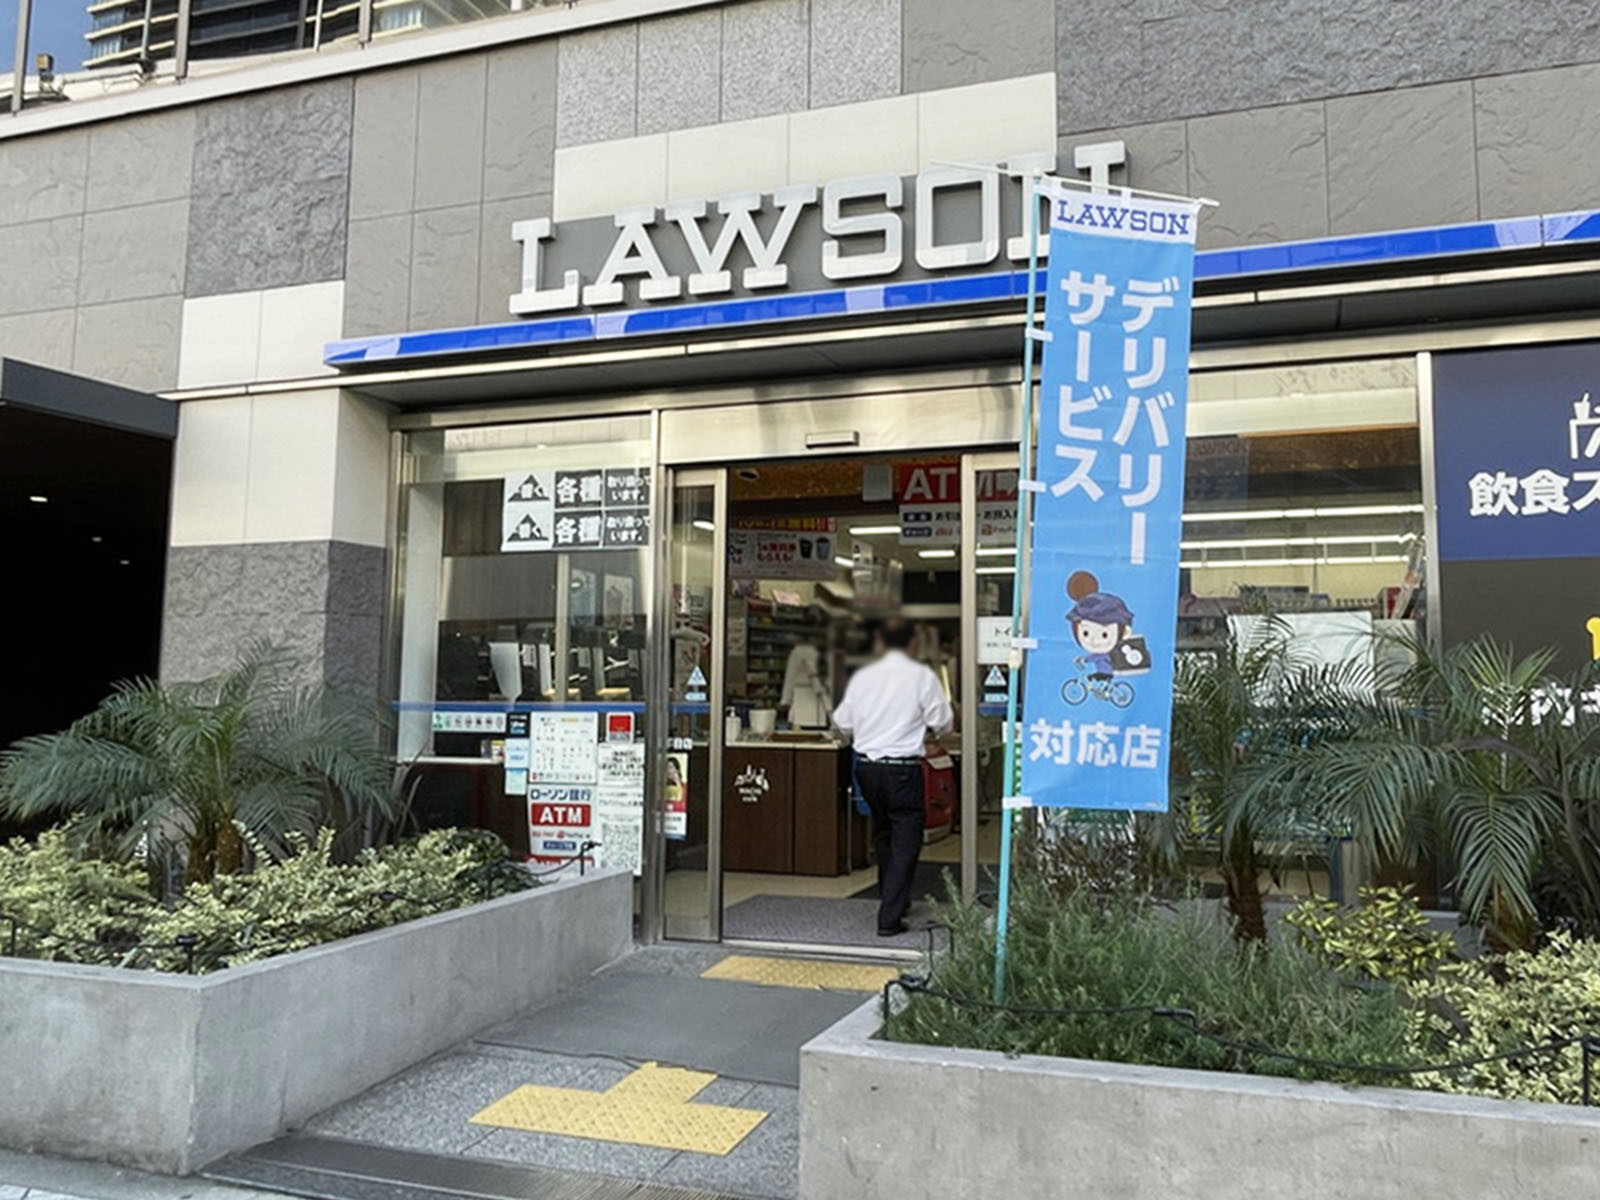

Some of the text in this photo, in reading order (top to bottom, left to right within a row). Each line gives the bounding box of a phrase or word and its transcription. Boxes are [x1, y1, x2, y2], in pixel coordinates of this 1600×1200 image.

[1056, 200, 1190, 236] LAWSON
[1050, 270, 1115, 502] サービス
[1112, 276, 1180, 565] デリバリー
[1029, 718, 1162, 769] 対応店
[539, 806, 583, 824] ATM
